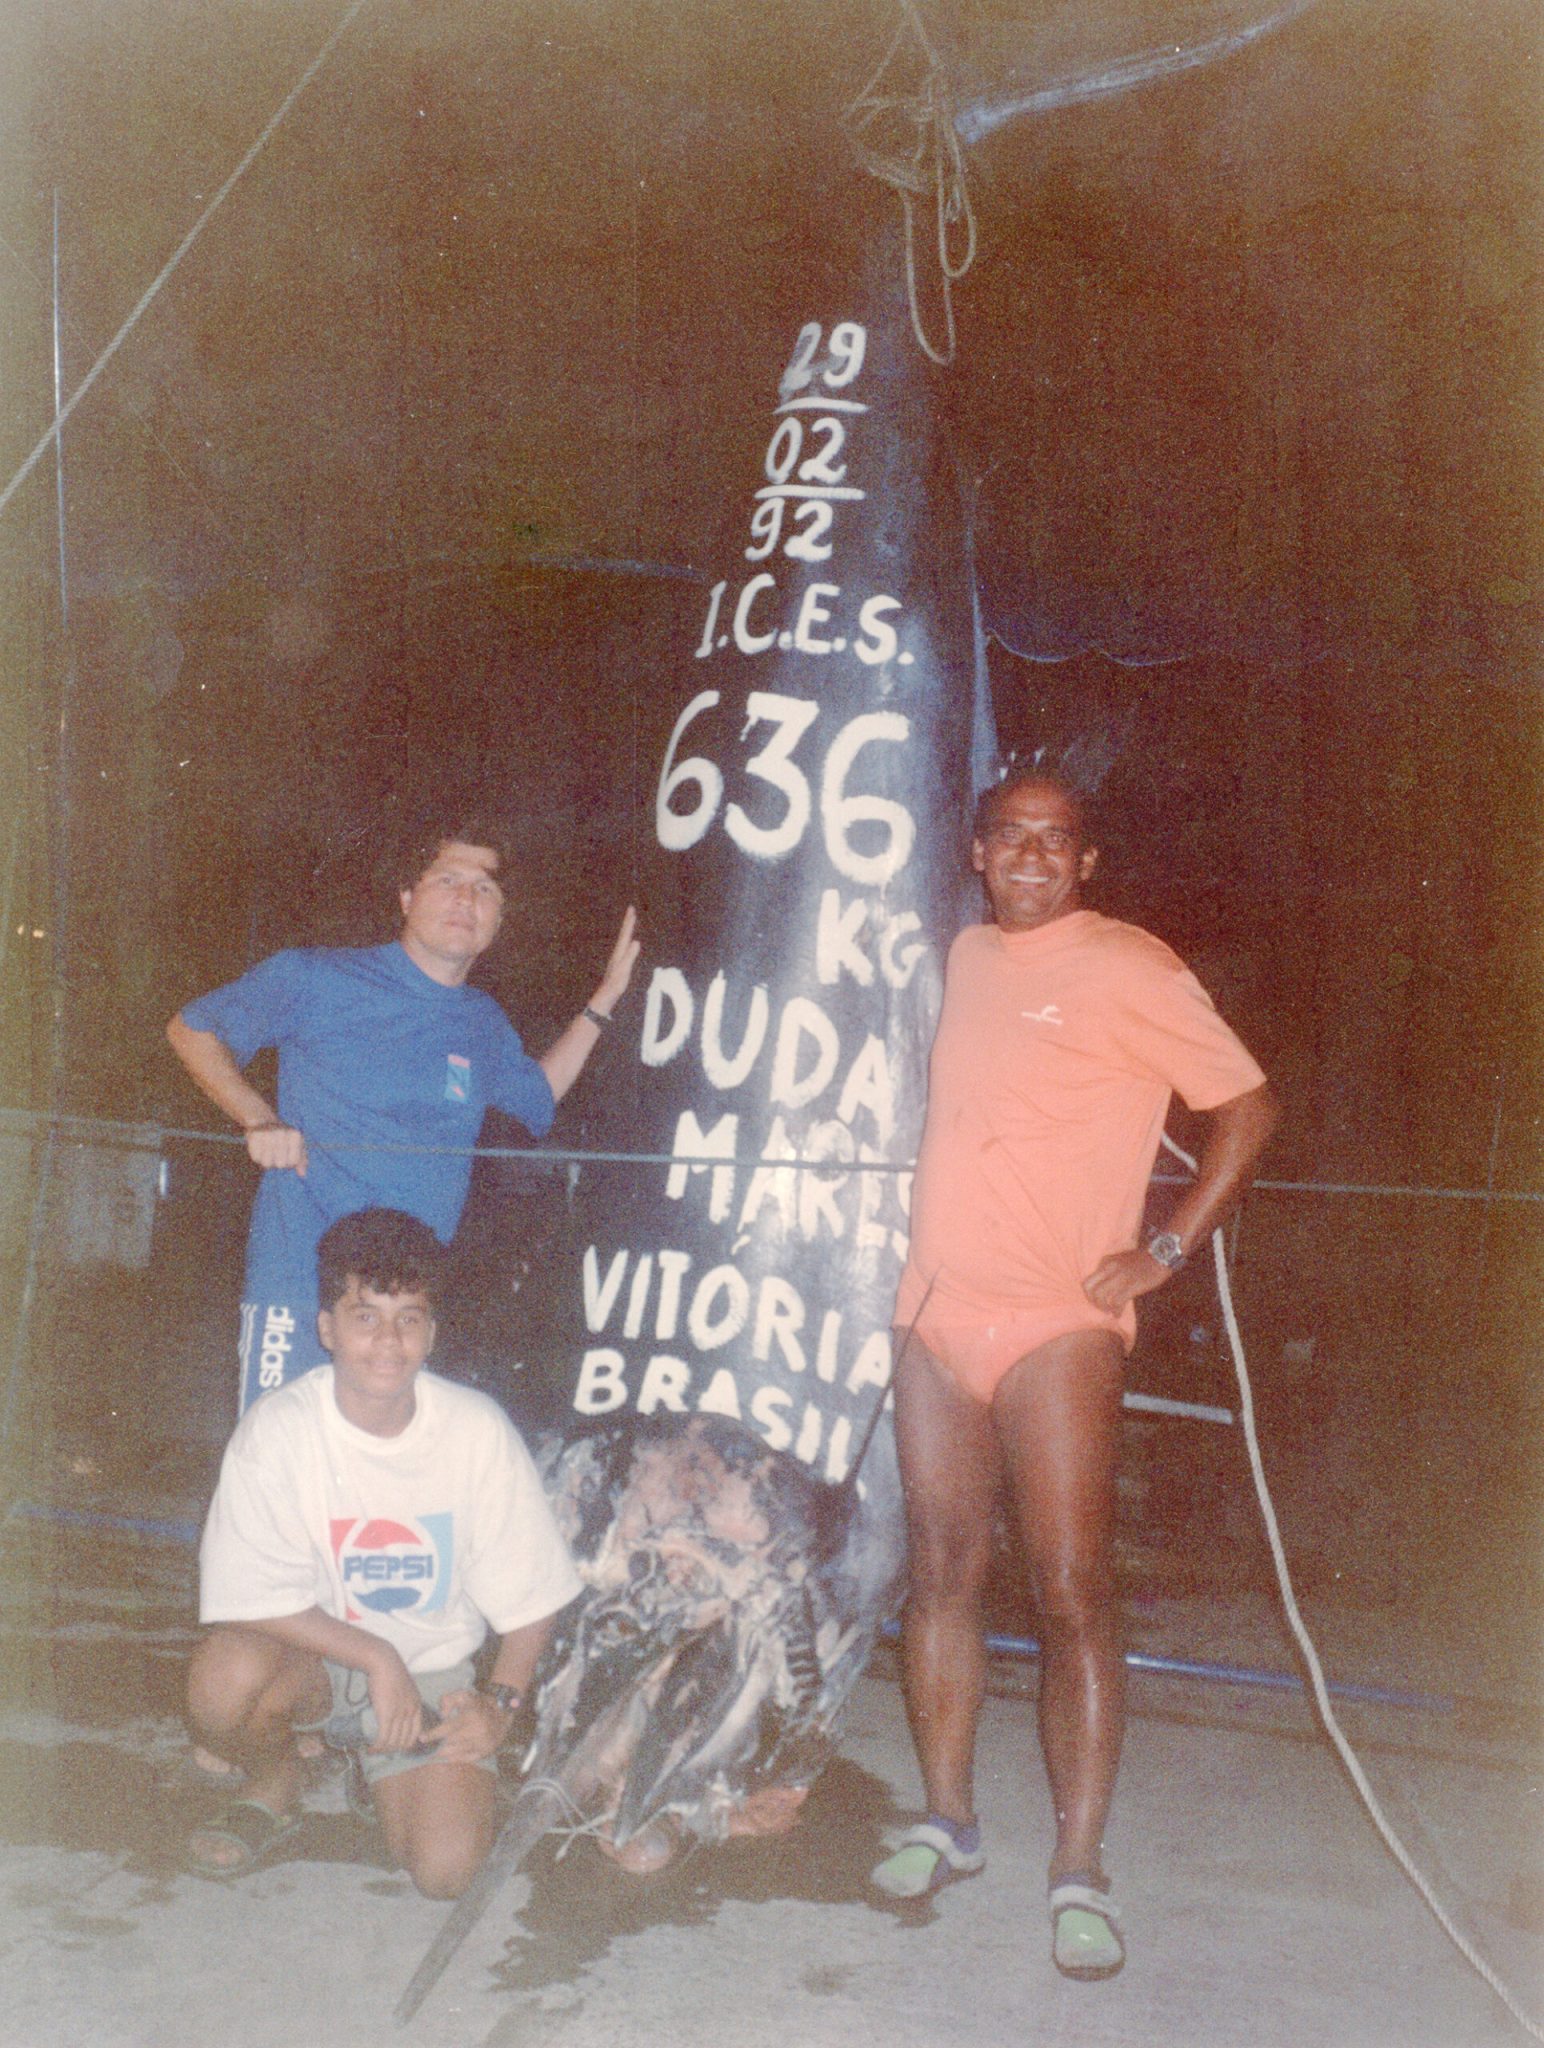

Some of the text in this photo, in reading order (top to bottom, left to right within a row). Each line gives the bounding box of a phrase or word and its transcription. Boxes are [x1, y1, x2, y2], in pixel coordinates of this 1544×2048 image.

[779, 322, 867, 399] 29
[764, 417, 847, 484] 02
[744, 497, 834, 562] 92
[695, 573, 915, 665] I.C.E.S.
[656, 689, 917, 887] 636
[816, 888, 928, 989] KG
[641, 967, 898, 1147] DUDA
[259, 1305, 295, 1389] didas
[573, 1348, 868, 1501] BRASIL
[343, 1554, 433, 1582] PEPSI
